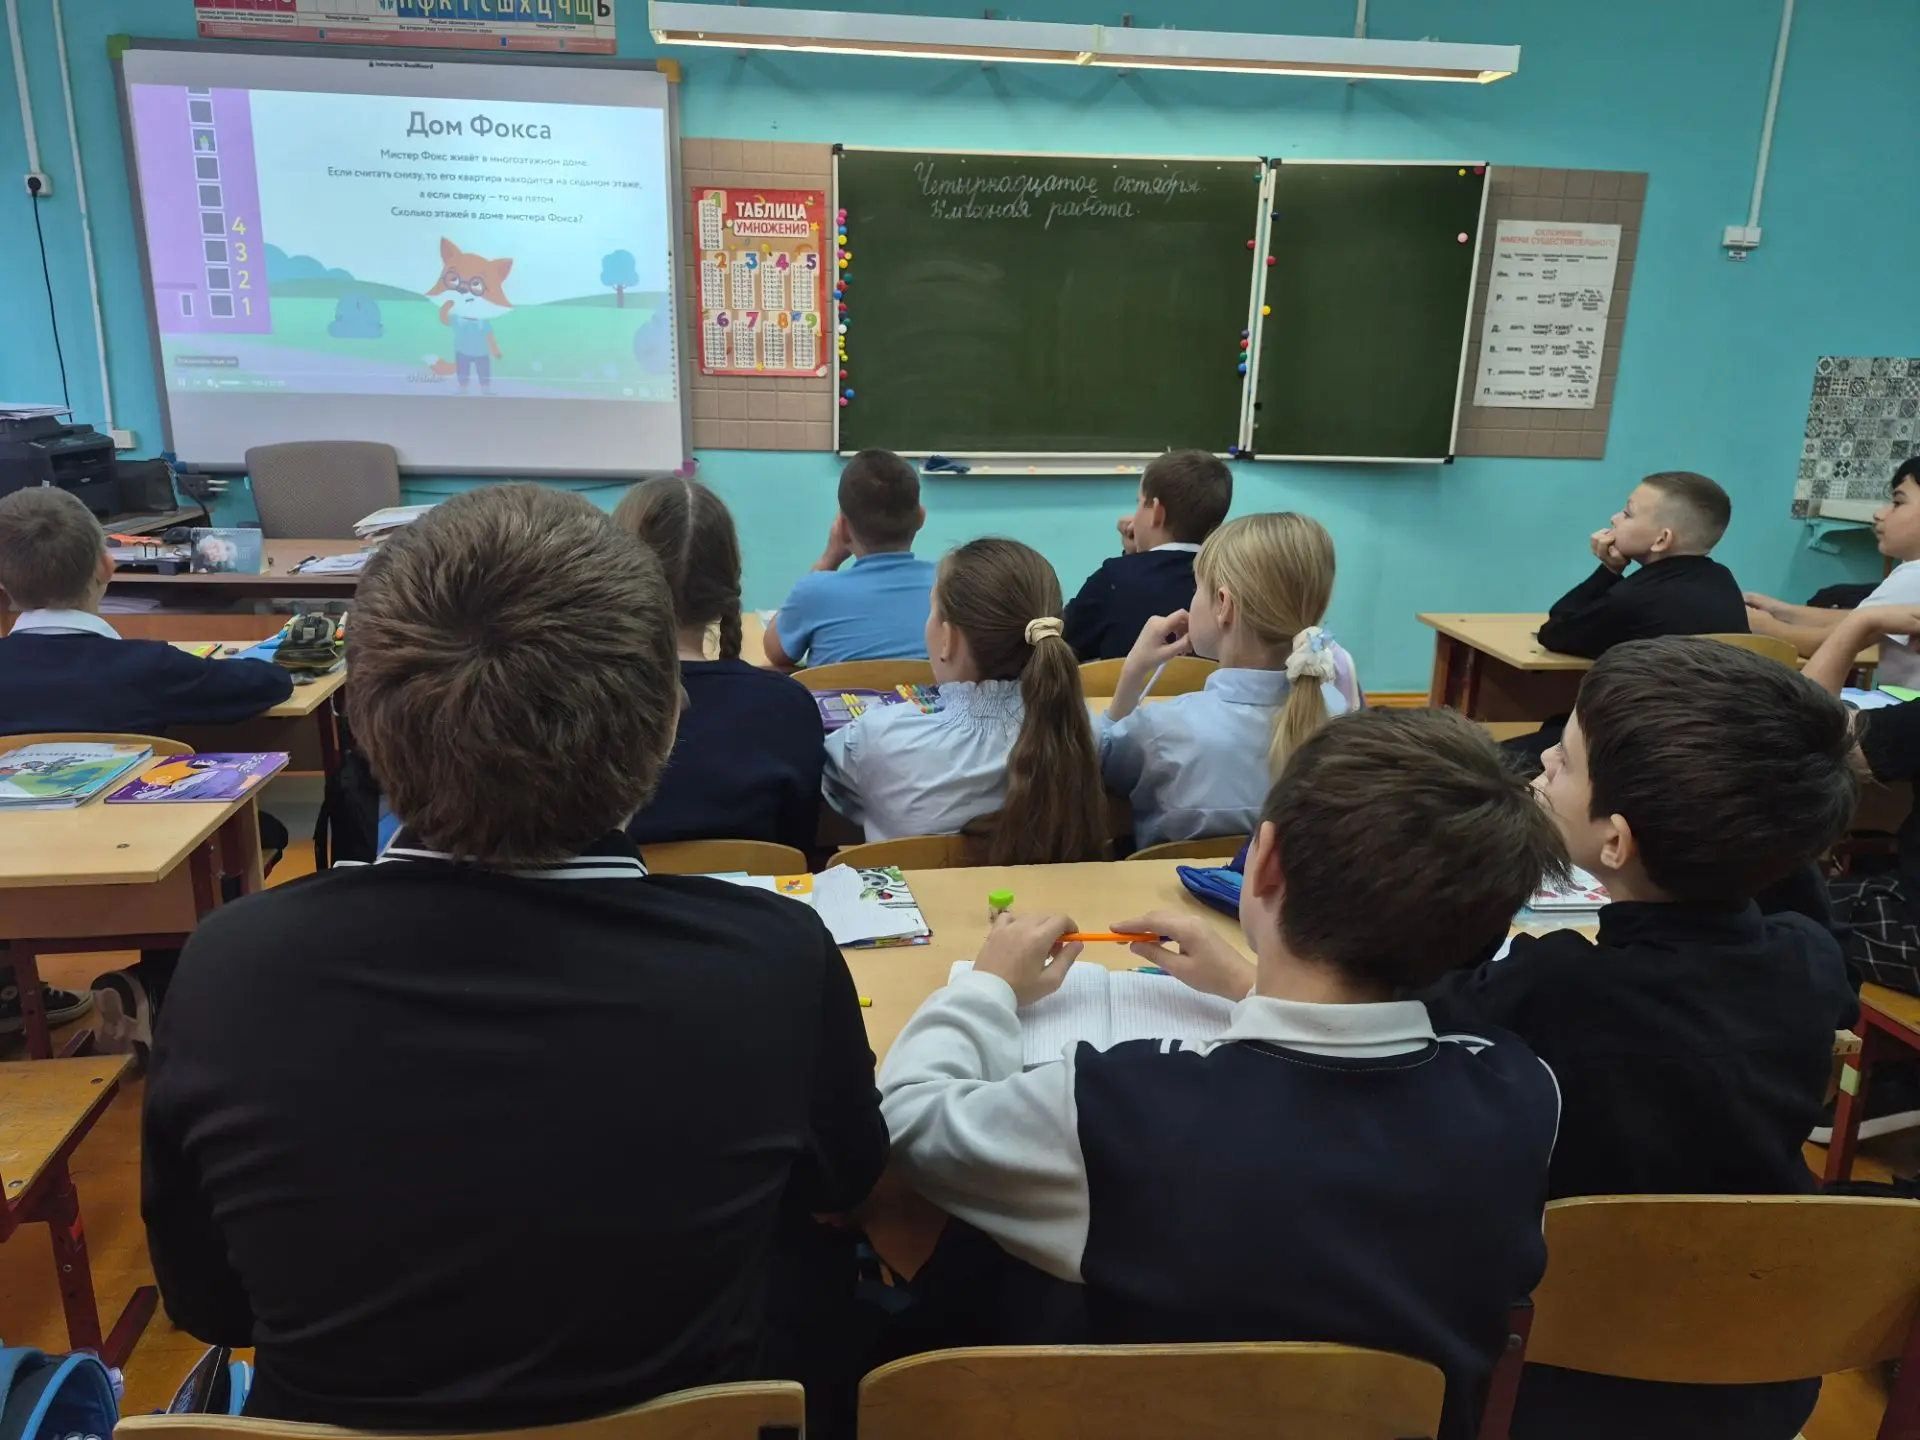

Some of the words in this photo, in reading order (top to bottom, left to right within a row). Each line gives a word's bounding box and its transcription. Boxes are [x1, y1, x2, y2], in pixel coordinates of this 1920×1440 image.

[406, 111, 463, 138] Дом
[470, 114, 552, 140] Фокса
[380, 149, 420, 162] Мистер
[421, 151, 448, 163] Фокс
[449, 154, 480, 163] живёт
[482, 155, 488, 163] в
[328, 166, 351, 177] Если
[354, 169, 392, 179] считать
[393, 171, 426, 182] снизу,
[427, 172, 437, 180] то
[439, 173, 456, 182] его
[458, 173, 502, 184] квартира
[504, 175, 554, 186] находится
[556, 178, 568, 186] на
[914, 160, 1099, 204] Четырнадцатое
[419, 190, 425, 199] а
[427, 190, 450, 200] если
[452, 191, 486, 203] сверху
[499, 193, 510, 202] то
[512, 194, 523, 203] на
[391, 206, 432, 218] Сколько
[434, 207, 470, 219] этажей
[471, 211, 477, 219] в
[479, 211, 504, 221] доме
[506, 212, 545, 223] мистера
[547, 212, 584, 224] Фокса?
[735, 202, 807, 221] ТАБЛИЦА
[231, 216, 247, 235] 4
[736, 220, 808, 235] УМНОЖЕНИЯ
[235, 242, 248, 262] 3
[714, 252, 727, 269] 2
[745, 253, 758, 270] 3
[776, 254, 789, 270] 4
[806, 254, 817, 270] 5
[238, 270, 251, 289] 2
[242, 297, 251, 316] 1
[717, 312, 730, 328] 6
[746, 312, 760, 329] 7
[778, 313, 789, 329] 8
[805, 313, 818, 329] 9
